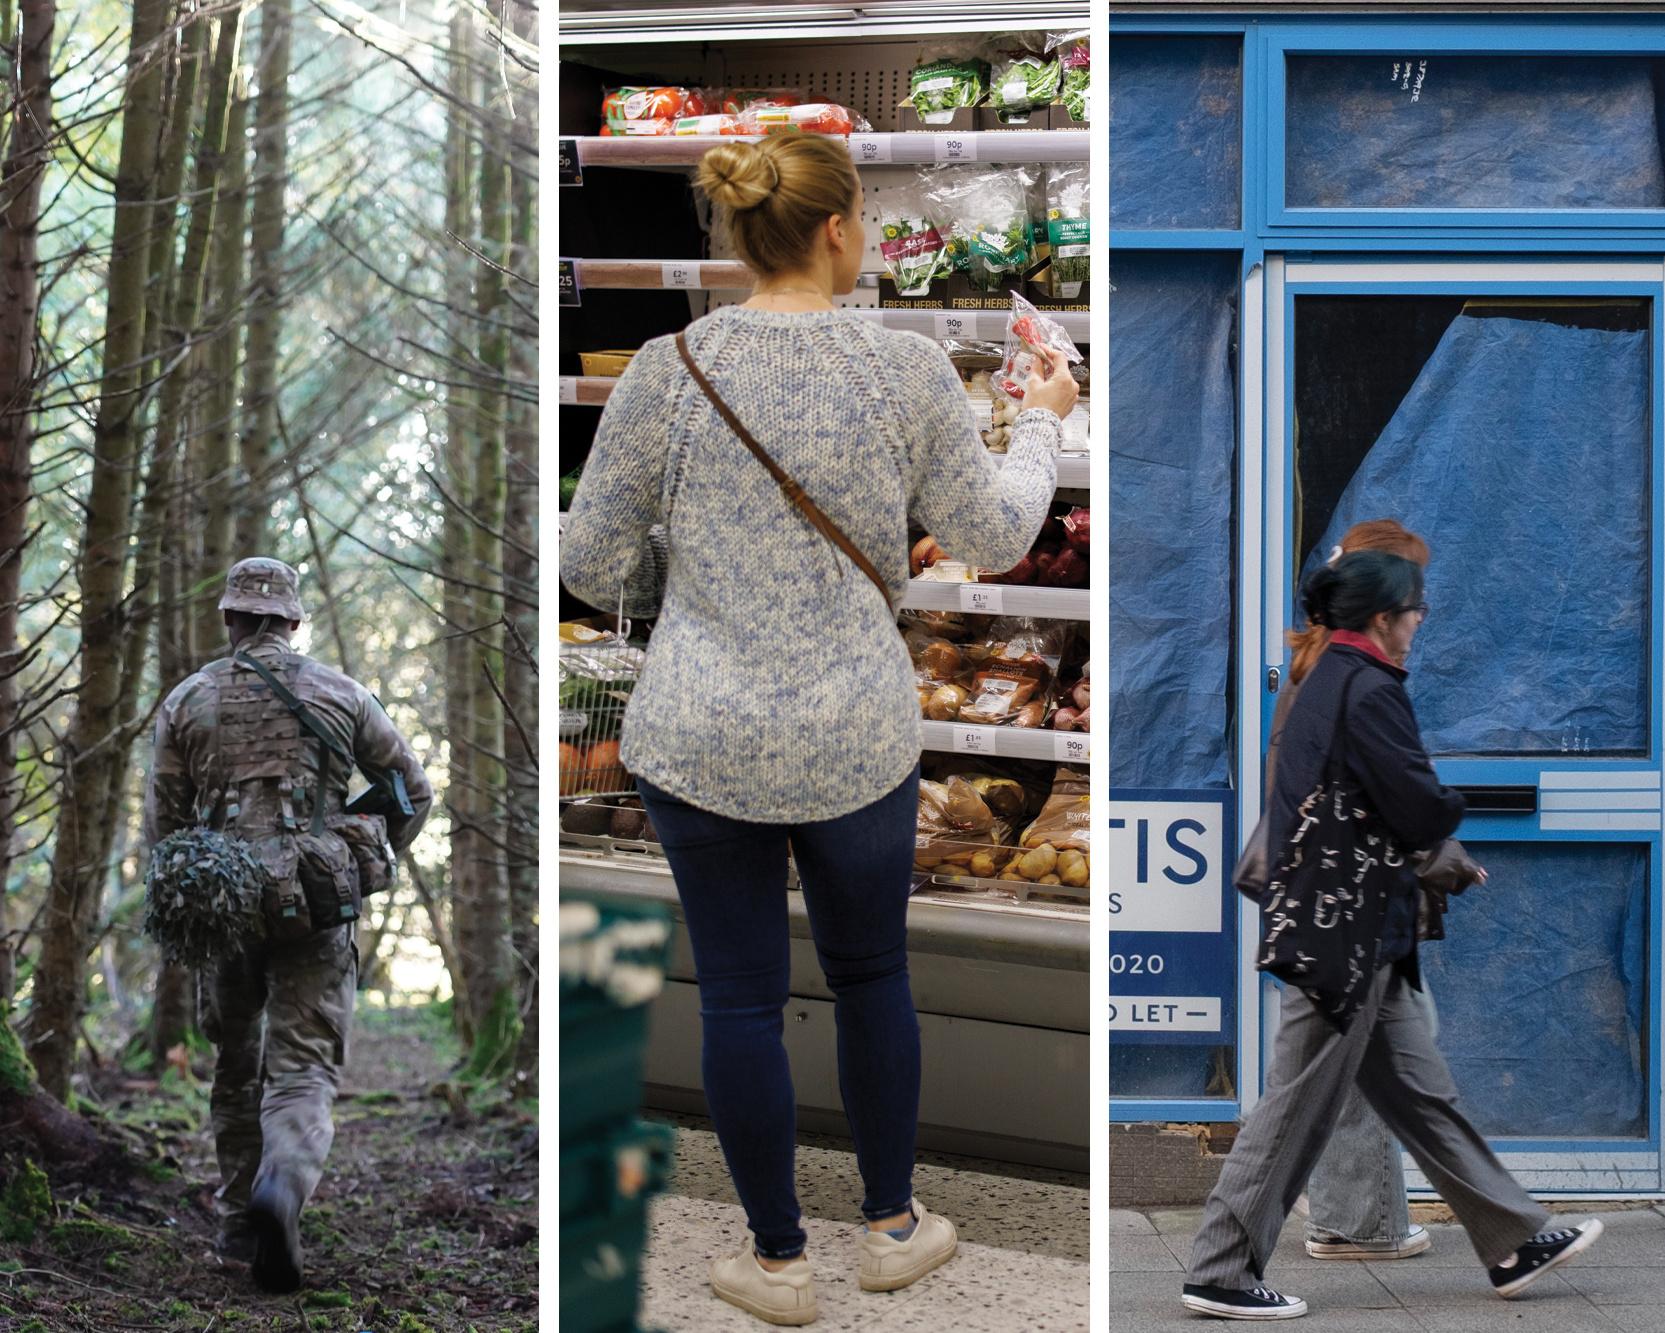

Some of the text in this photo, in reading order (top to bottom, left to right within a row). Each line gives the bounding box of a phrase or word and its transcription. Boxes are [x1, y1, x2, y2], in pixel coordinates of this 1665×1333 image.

[861, 143, 877, 152] 90p
[946, 140, 962, 149] 90p
[1061, 222, 1087, 231] THYME
[883, 300, 943, 309] FRESH HERBS
[952, 297, 1013, 308] FRESH HERBS
[1064, 304, 1089, 312] HERB
[946, 319, 962, 329] 90p
[1066, 740, 1083, 751] 90p
[1109, 954, 1164, 974] 020
[1131, 1004, 1179, 1023] LET
